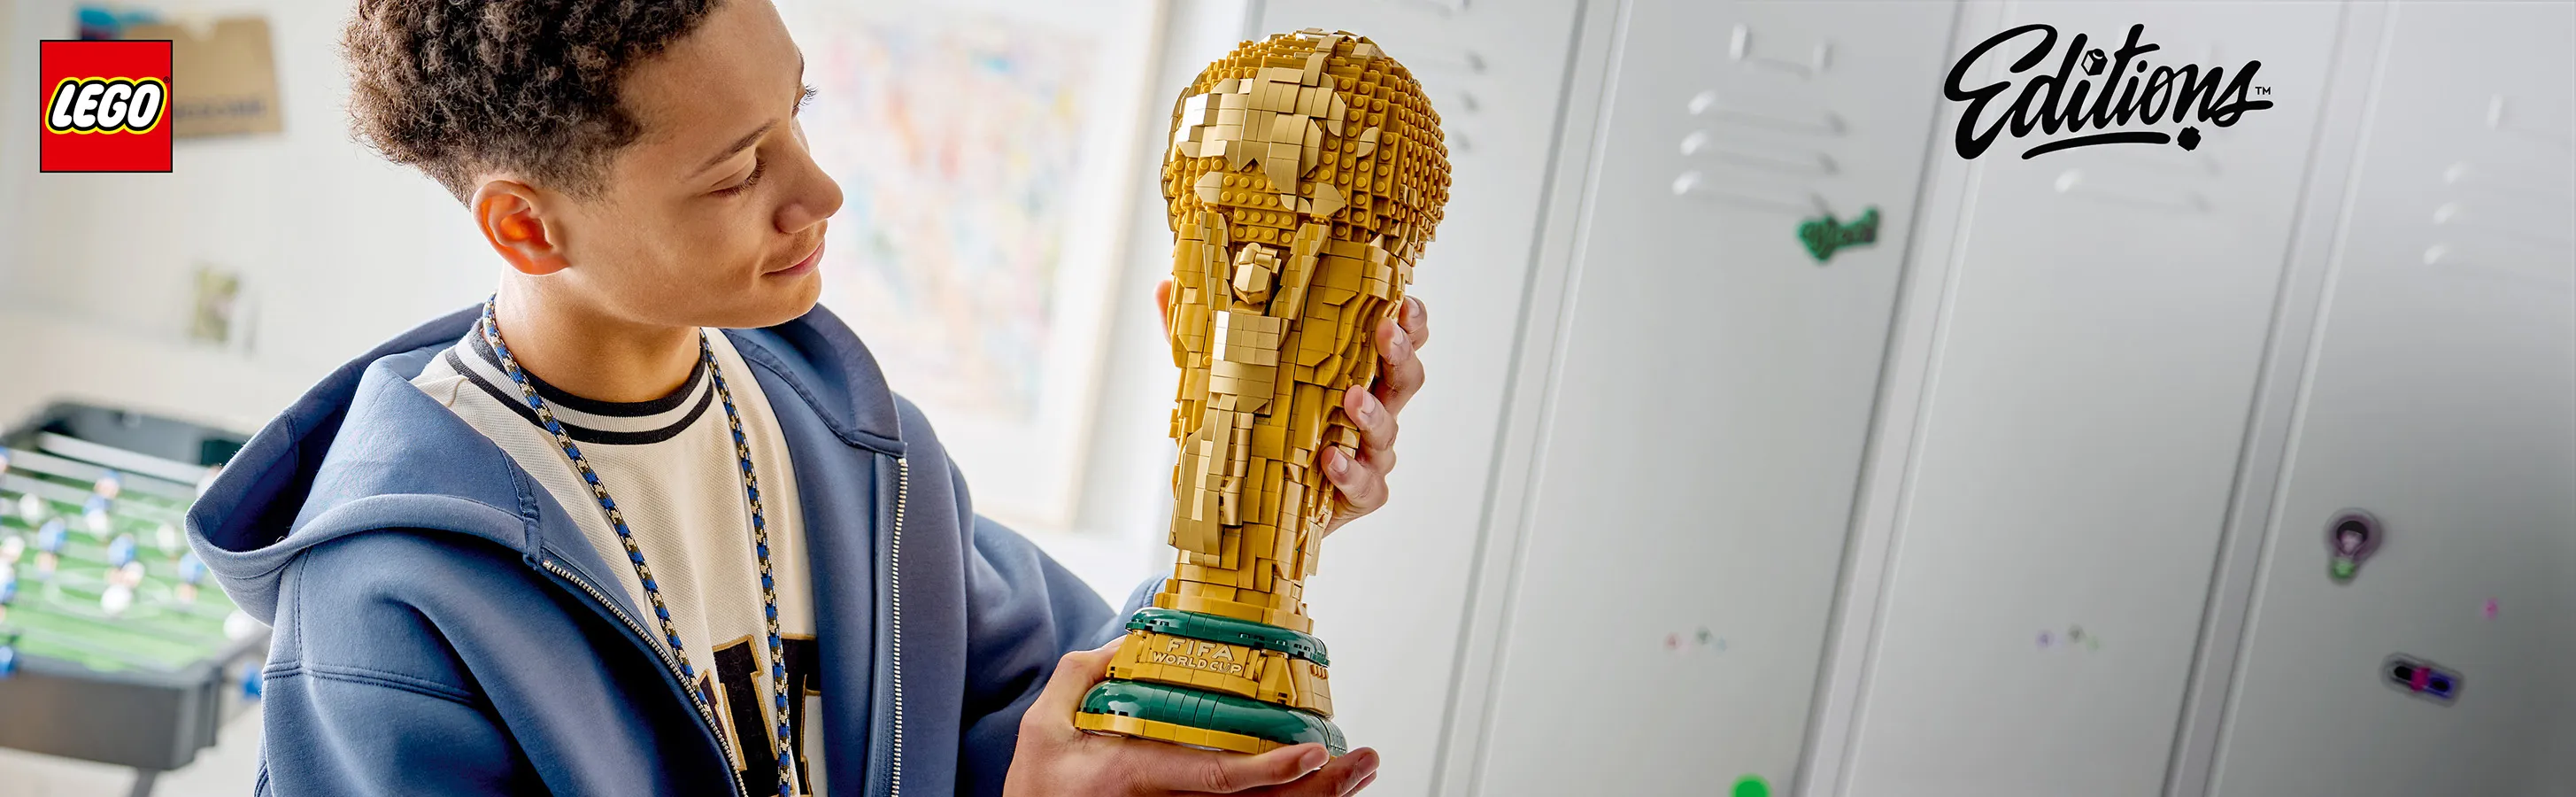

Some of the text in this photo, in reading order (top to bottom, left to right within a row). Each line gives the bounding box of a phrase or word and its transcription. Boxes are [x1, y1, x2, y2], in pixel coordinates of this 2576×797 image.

[1167, 637, 1234, 662] FIFA
[1153, 651, 1243, 674] WORLD CUP
